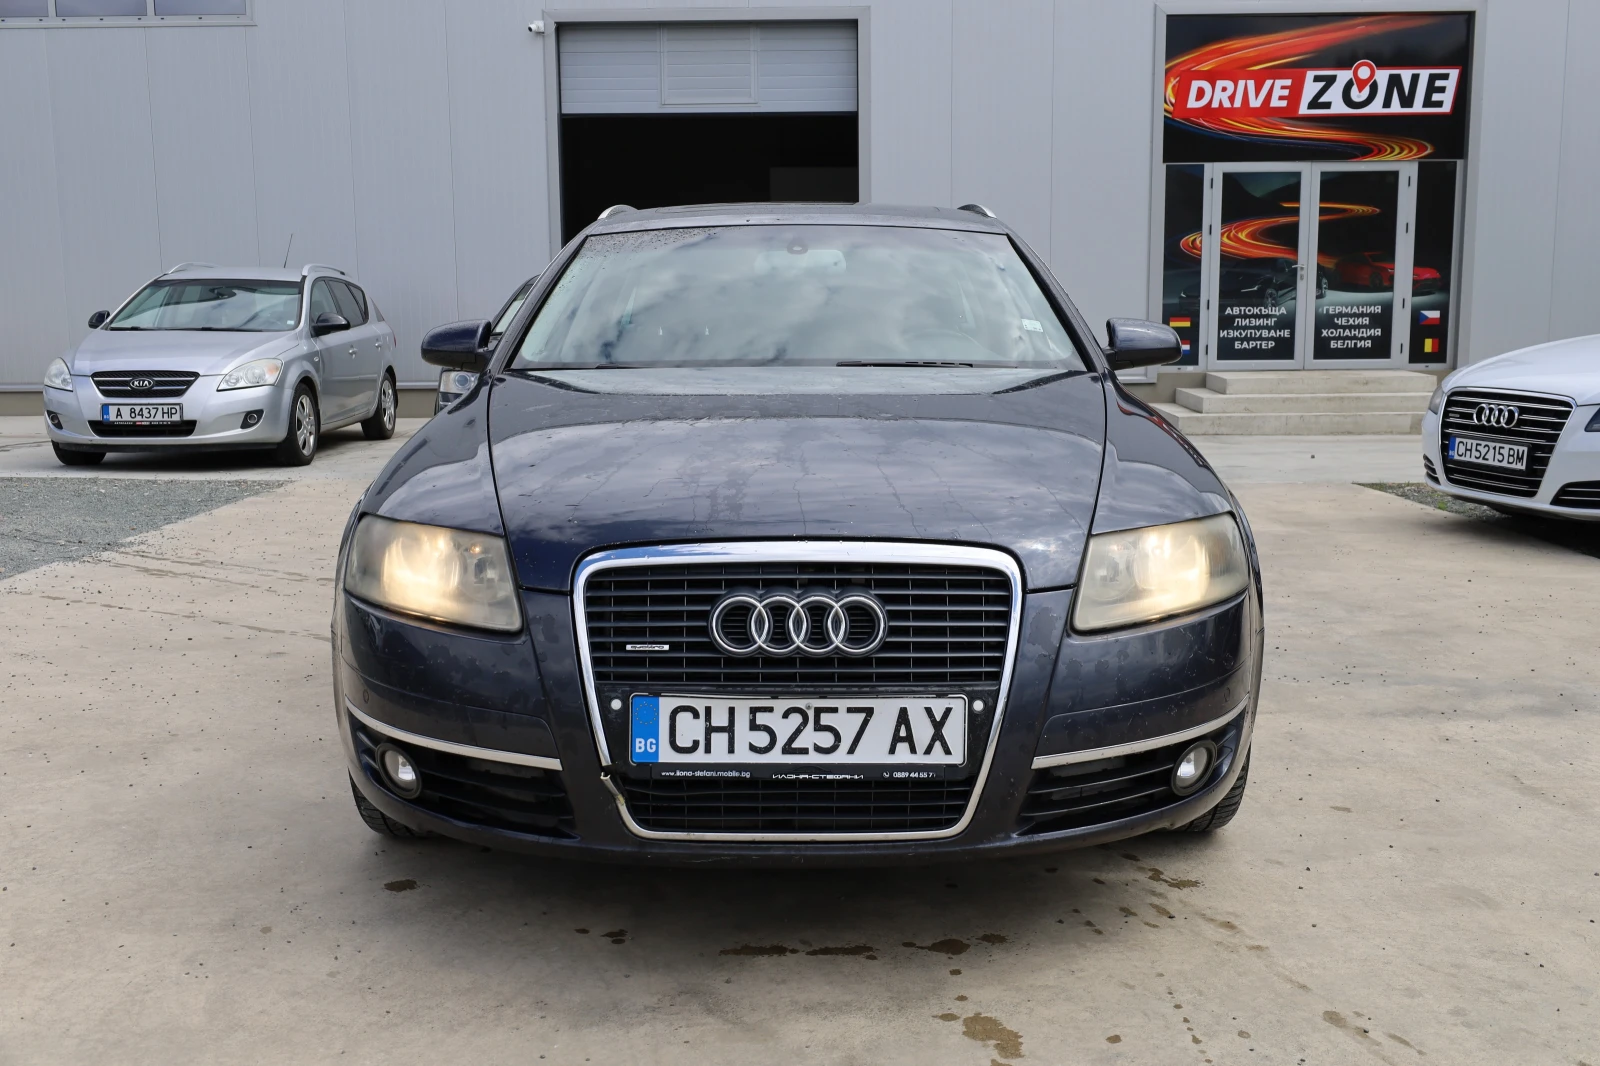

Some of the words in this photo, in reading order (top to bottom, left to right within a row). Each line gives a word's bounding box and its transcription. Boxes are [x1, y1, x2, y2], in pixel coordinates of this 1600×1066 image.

[1186, 79, 1292, 108] DRIVE
[1307, 73, 1450, 109] ZONE
[1225, 306, 1287, 316] АВТОКЪЩА
[1323, 305, 1382, 315] ГЕРМАНИЯ
[1233, 317, 1278, 327] ЛИЗИНГ
[1334, 317, 1370, 326] ЧЕХИЯ
[1219, 329, 1291, 339] ИЗКУПУВАНЕ
[1321, 328, 1382, 338] ХОЛАНДИЯ
[1234, 340, 1275, 350] БАРТЕР
[1330, 340, 1372, 349] БЕЛГИЯ
[115, 407, 123, 419] A
[129, 406, 159, 419] 8437
[161, 406, 178, 419] HP
[1456, 440, 1474, 459] CH
[1474, 442, 1505, 463] 5215
[1507, 447, 1525, 466] BM
[668, 705, 736, 755] CH
[748, 706, 875, 755] 5257
[887, 706, 953, 756] AX
[635, 737, 657, 753] BG
